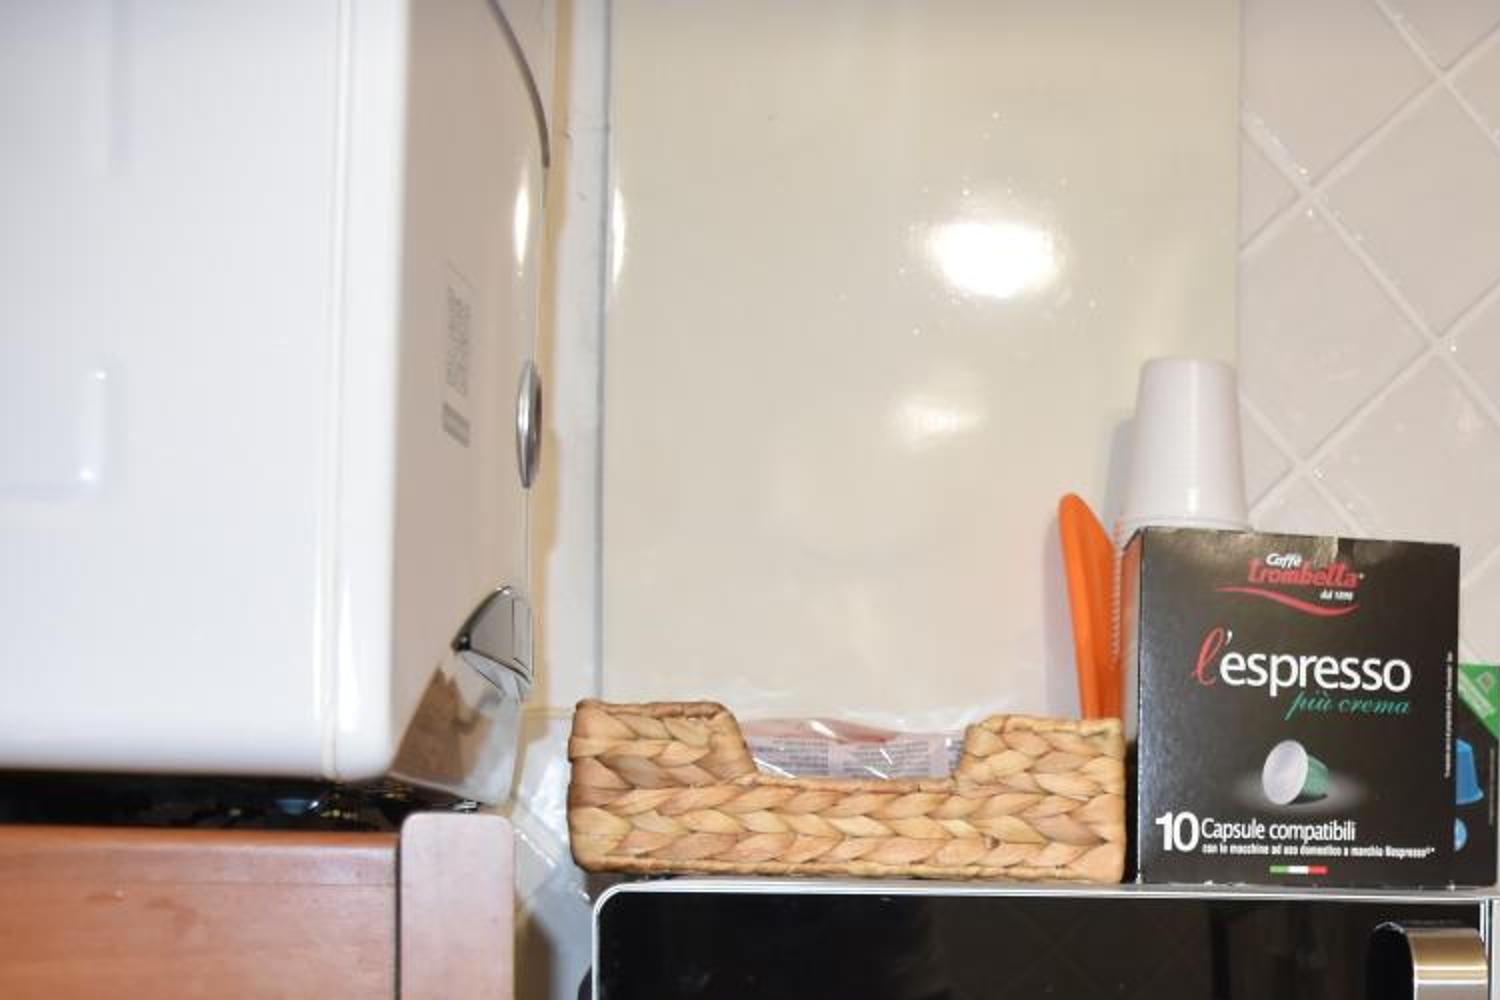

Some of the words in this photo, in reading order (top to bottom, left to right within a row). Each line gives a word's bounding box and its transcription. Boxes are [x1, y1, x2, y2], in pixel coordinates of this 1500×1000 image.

[1338, 697, 1410, 716] crema
[1155, 811, 1200, 853] 10
[1201, 817, 1265, 843] Capsule
[1268, 819, 1357, 845] compatibili
